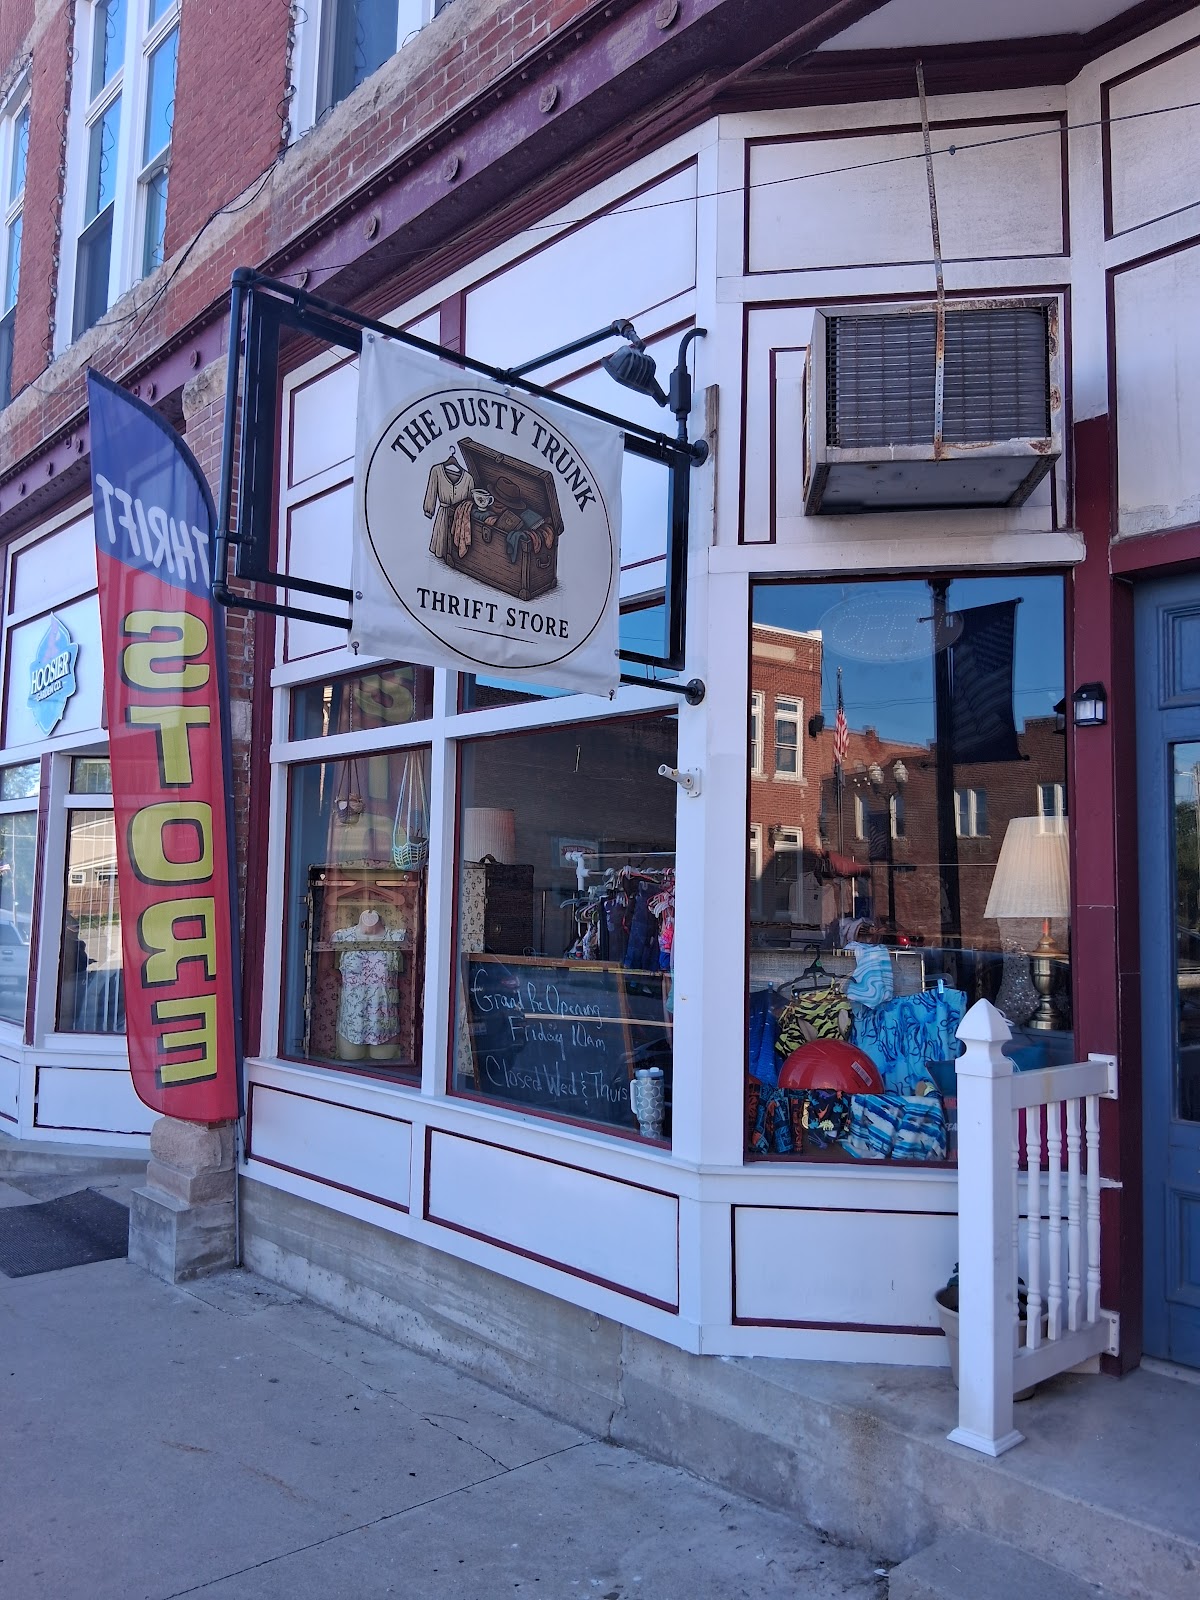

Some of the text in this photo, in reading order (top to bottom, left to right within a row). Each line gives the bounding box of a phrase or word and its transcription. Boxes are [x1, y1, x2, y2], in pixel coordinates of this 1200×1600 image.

[391, 398, 597, 513] THE DUSTY TRUNK
[417, 587, 569, 639] THRIFT STORE
[833, 614, 944, 643] OPEN
[31, 651, 71, 695] HOOSIER
[508, 1015, 566, 1060] Friday
[486, 1055, 543, 1092] Closed
[543, 1061, 577, 1096] Wed
[586, 1071, 627, 1103] Thurs
